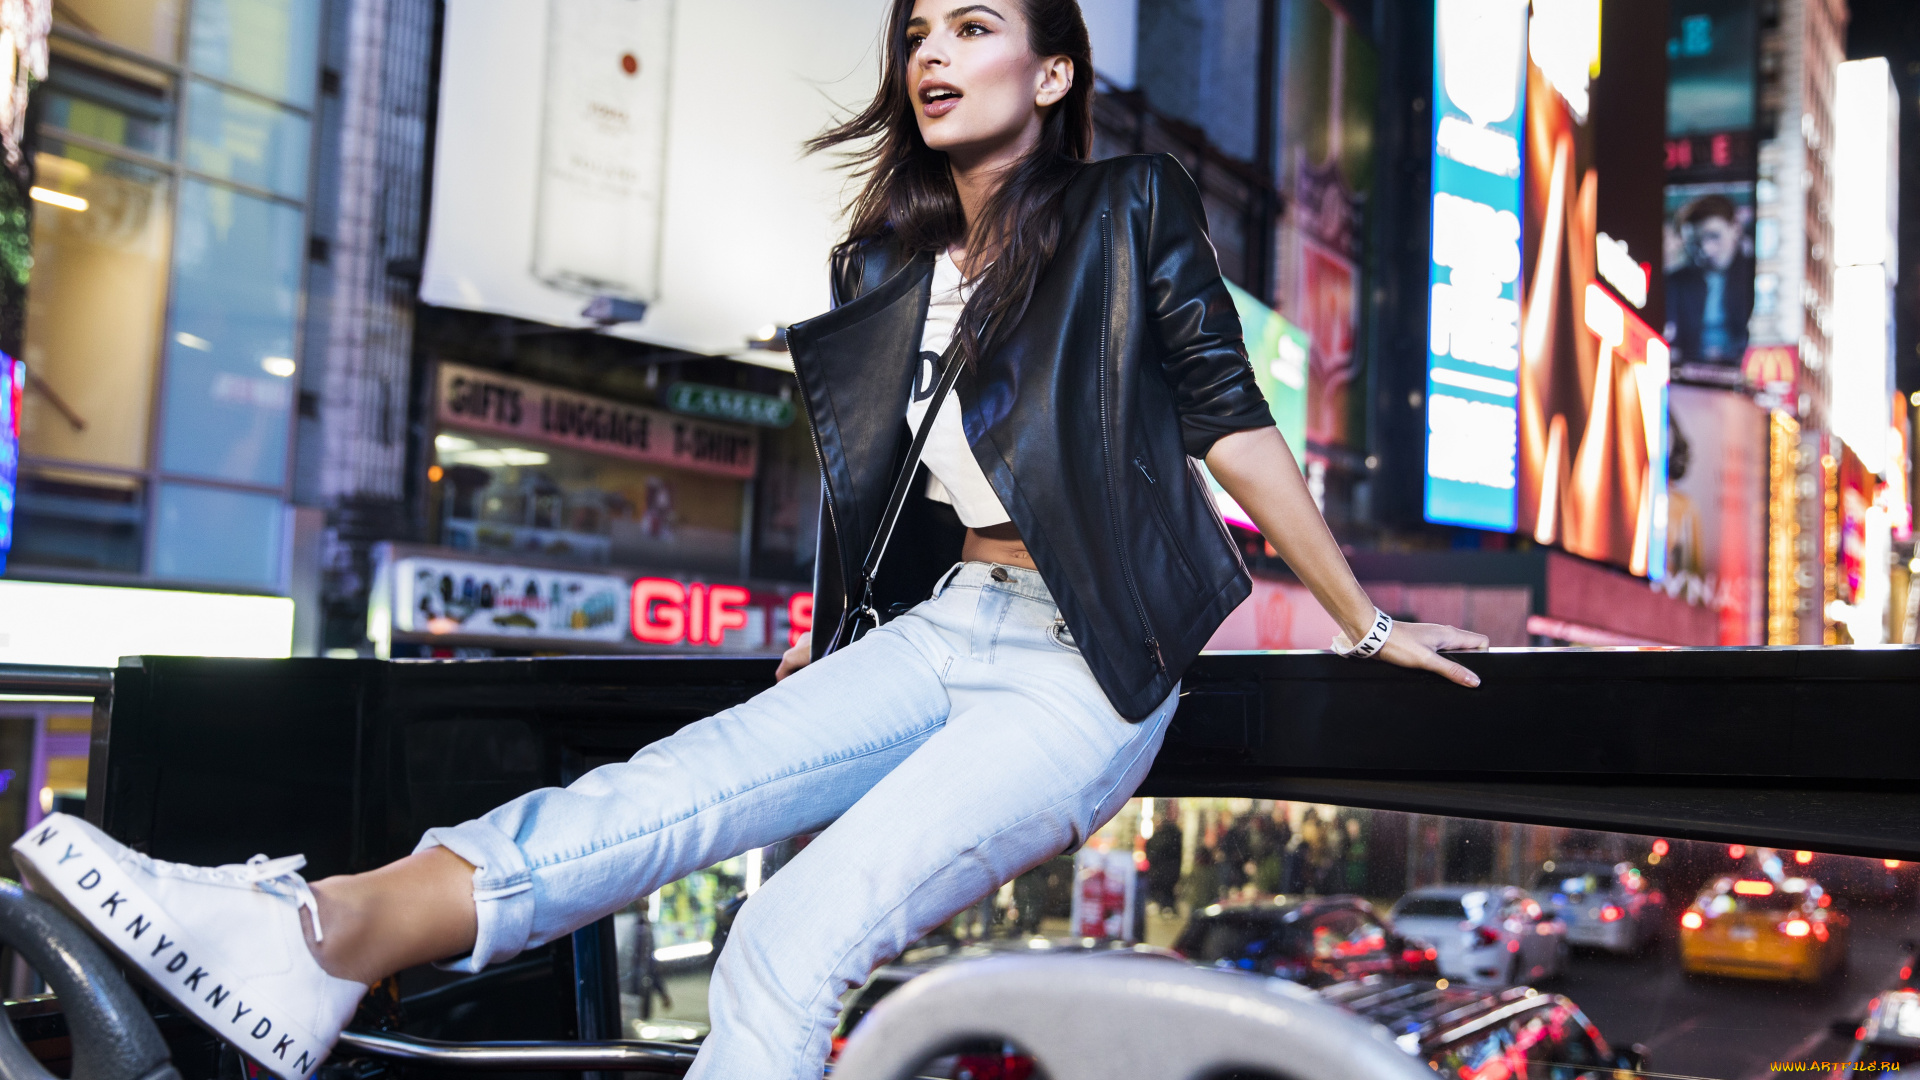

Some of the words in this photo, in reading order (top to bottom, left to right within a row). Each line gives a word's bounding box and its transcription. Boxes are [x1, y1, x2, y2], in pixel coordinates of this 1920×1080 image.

[451, 377, 523, 427] GIFTS
[541, 393, 651, 450] LUGGAGE
[672, 421, 750, 466] T-SHIRT
